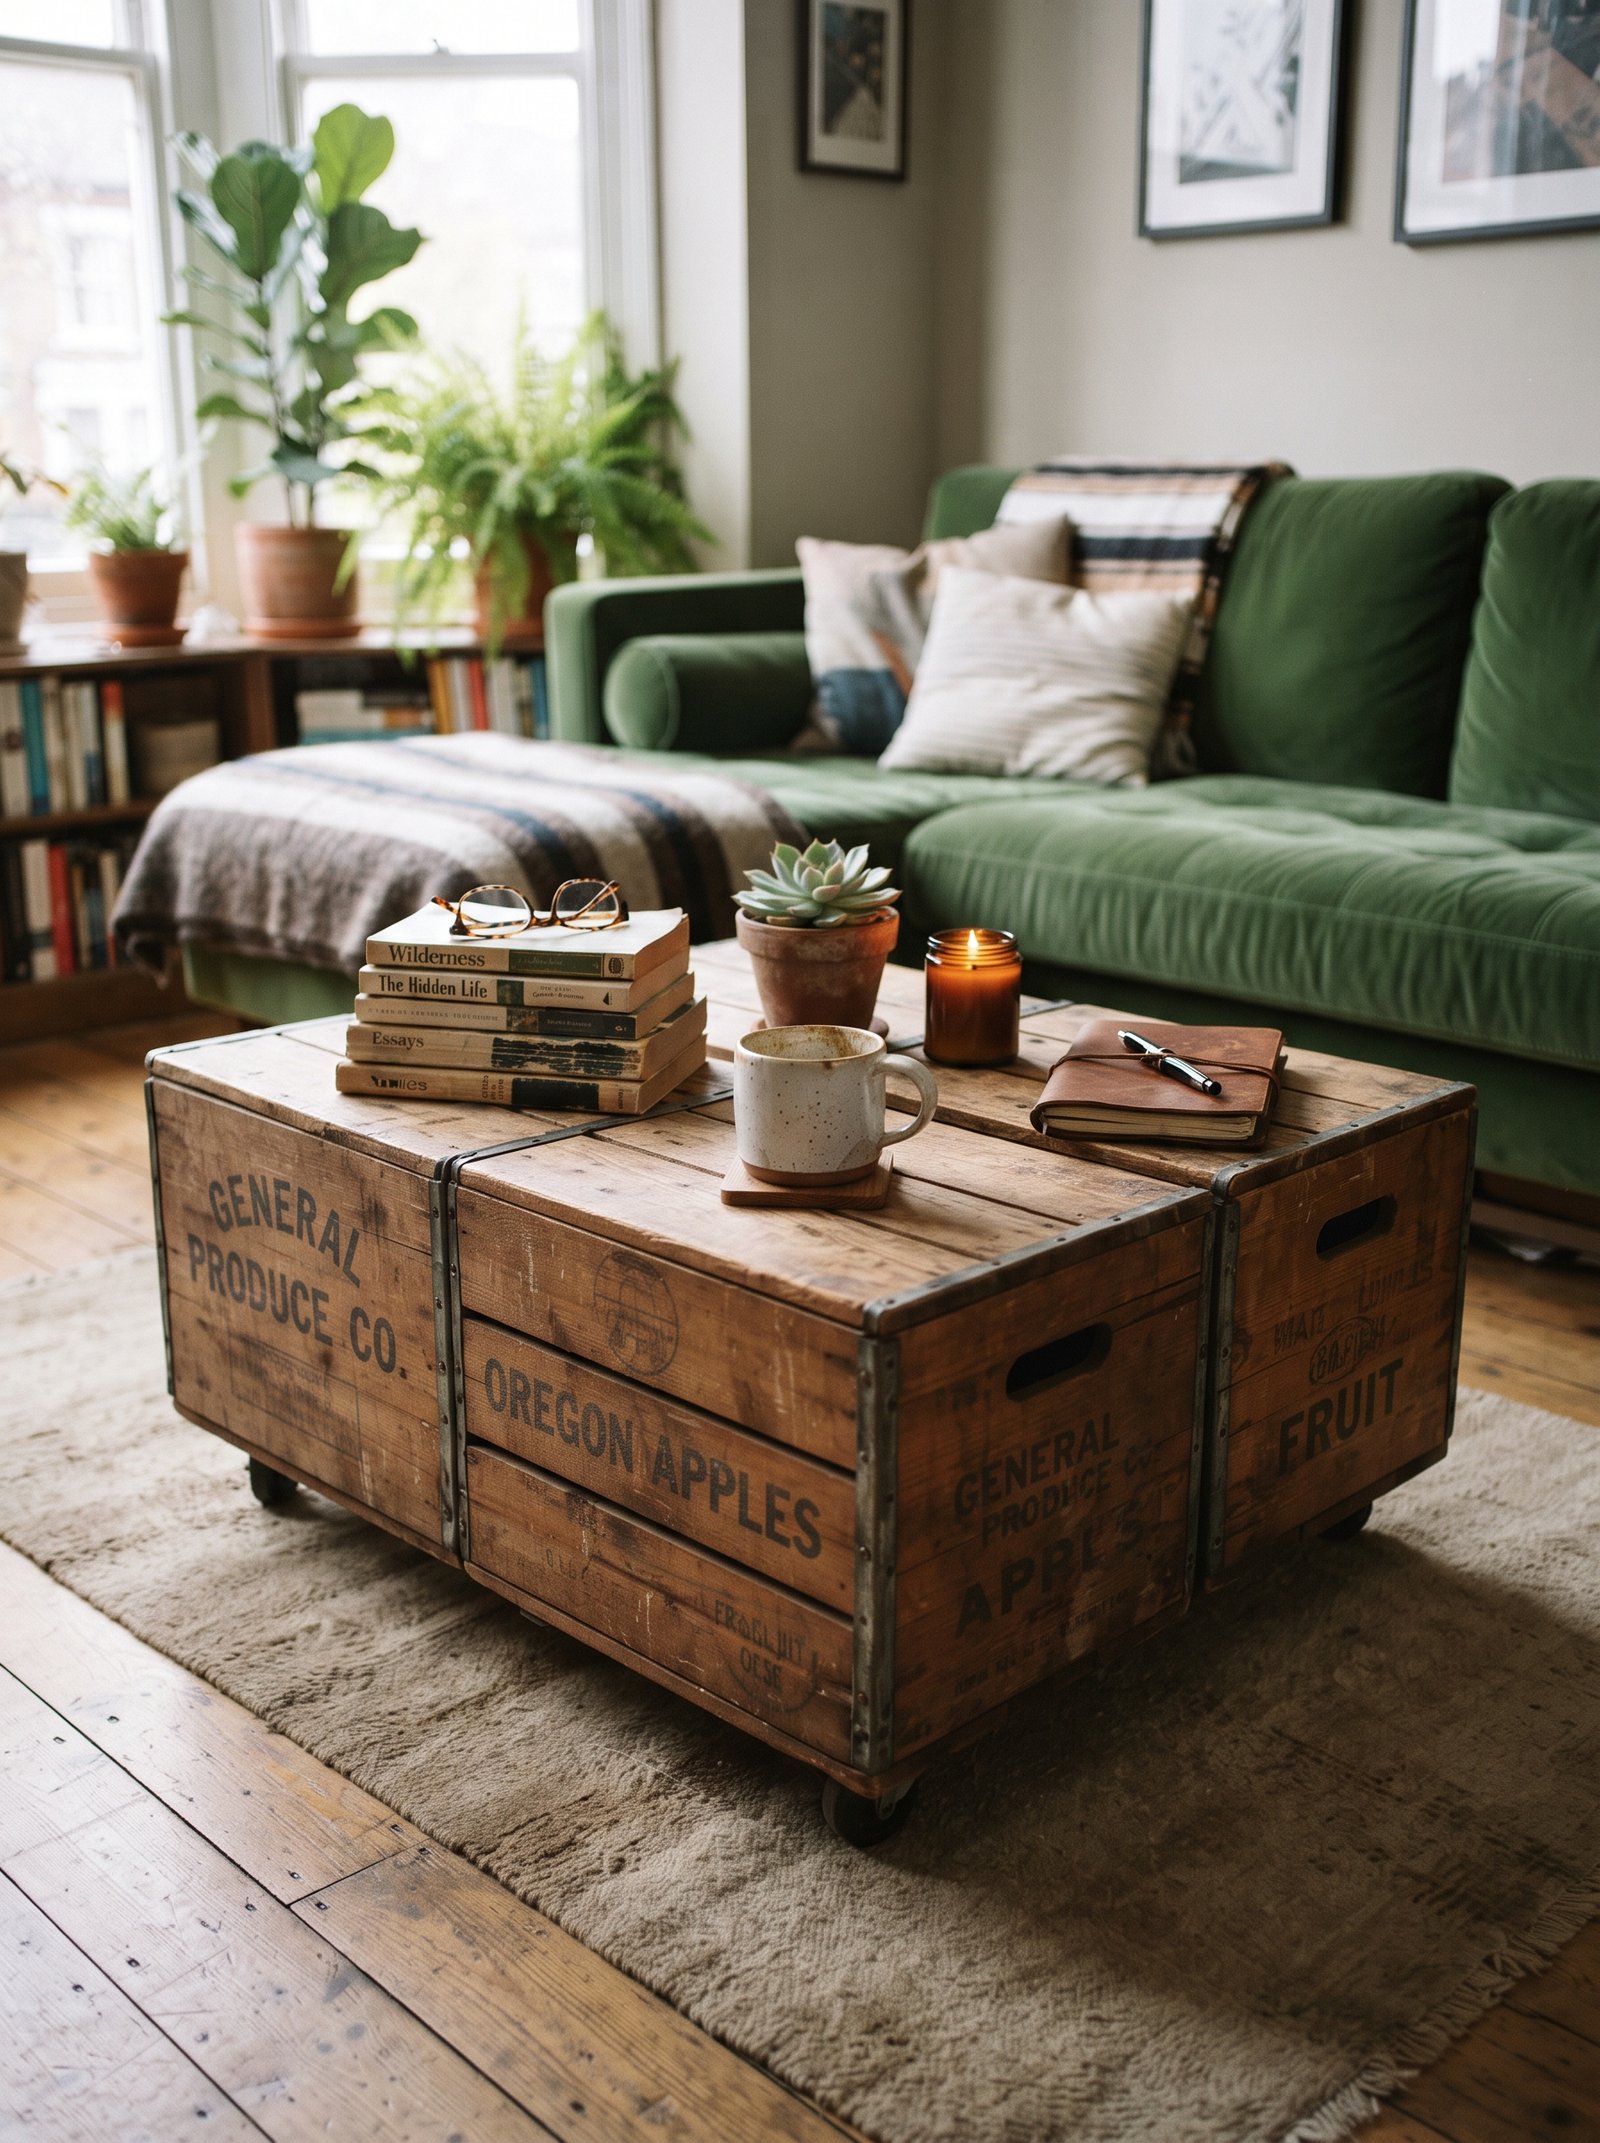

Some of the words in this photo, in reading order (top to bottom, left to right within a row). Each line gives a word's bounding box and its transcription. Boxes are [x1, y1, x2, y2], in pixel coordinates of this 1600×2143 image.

[378, 974, 405, 994] The
[408, 975, 457, 997] Hidden
[461, 978, 488, 999] Life
[388, 944, 486, 968] Wilderness
[371, 1030, 425, 1050] Essays
[208, 1173, 361, 1288] GENERAL
[186, 1232, 334, 1347] PRODUCE
[484, 1358, 636, 1474] OREGON
[652, 1434, 823, 1560] APPLES
[953, 1412, 1121, 1526] GENERAL
[1278, 1357, 1404, 1476] FRUIT
